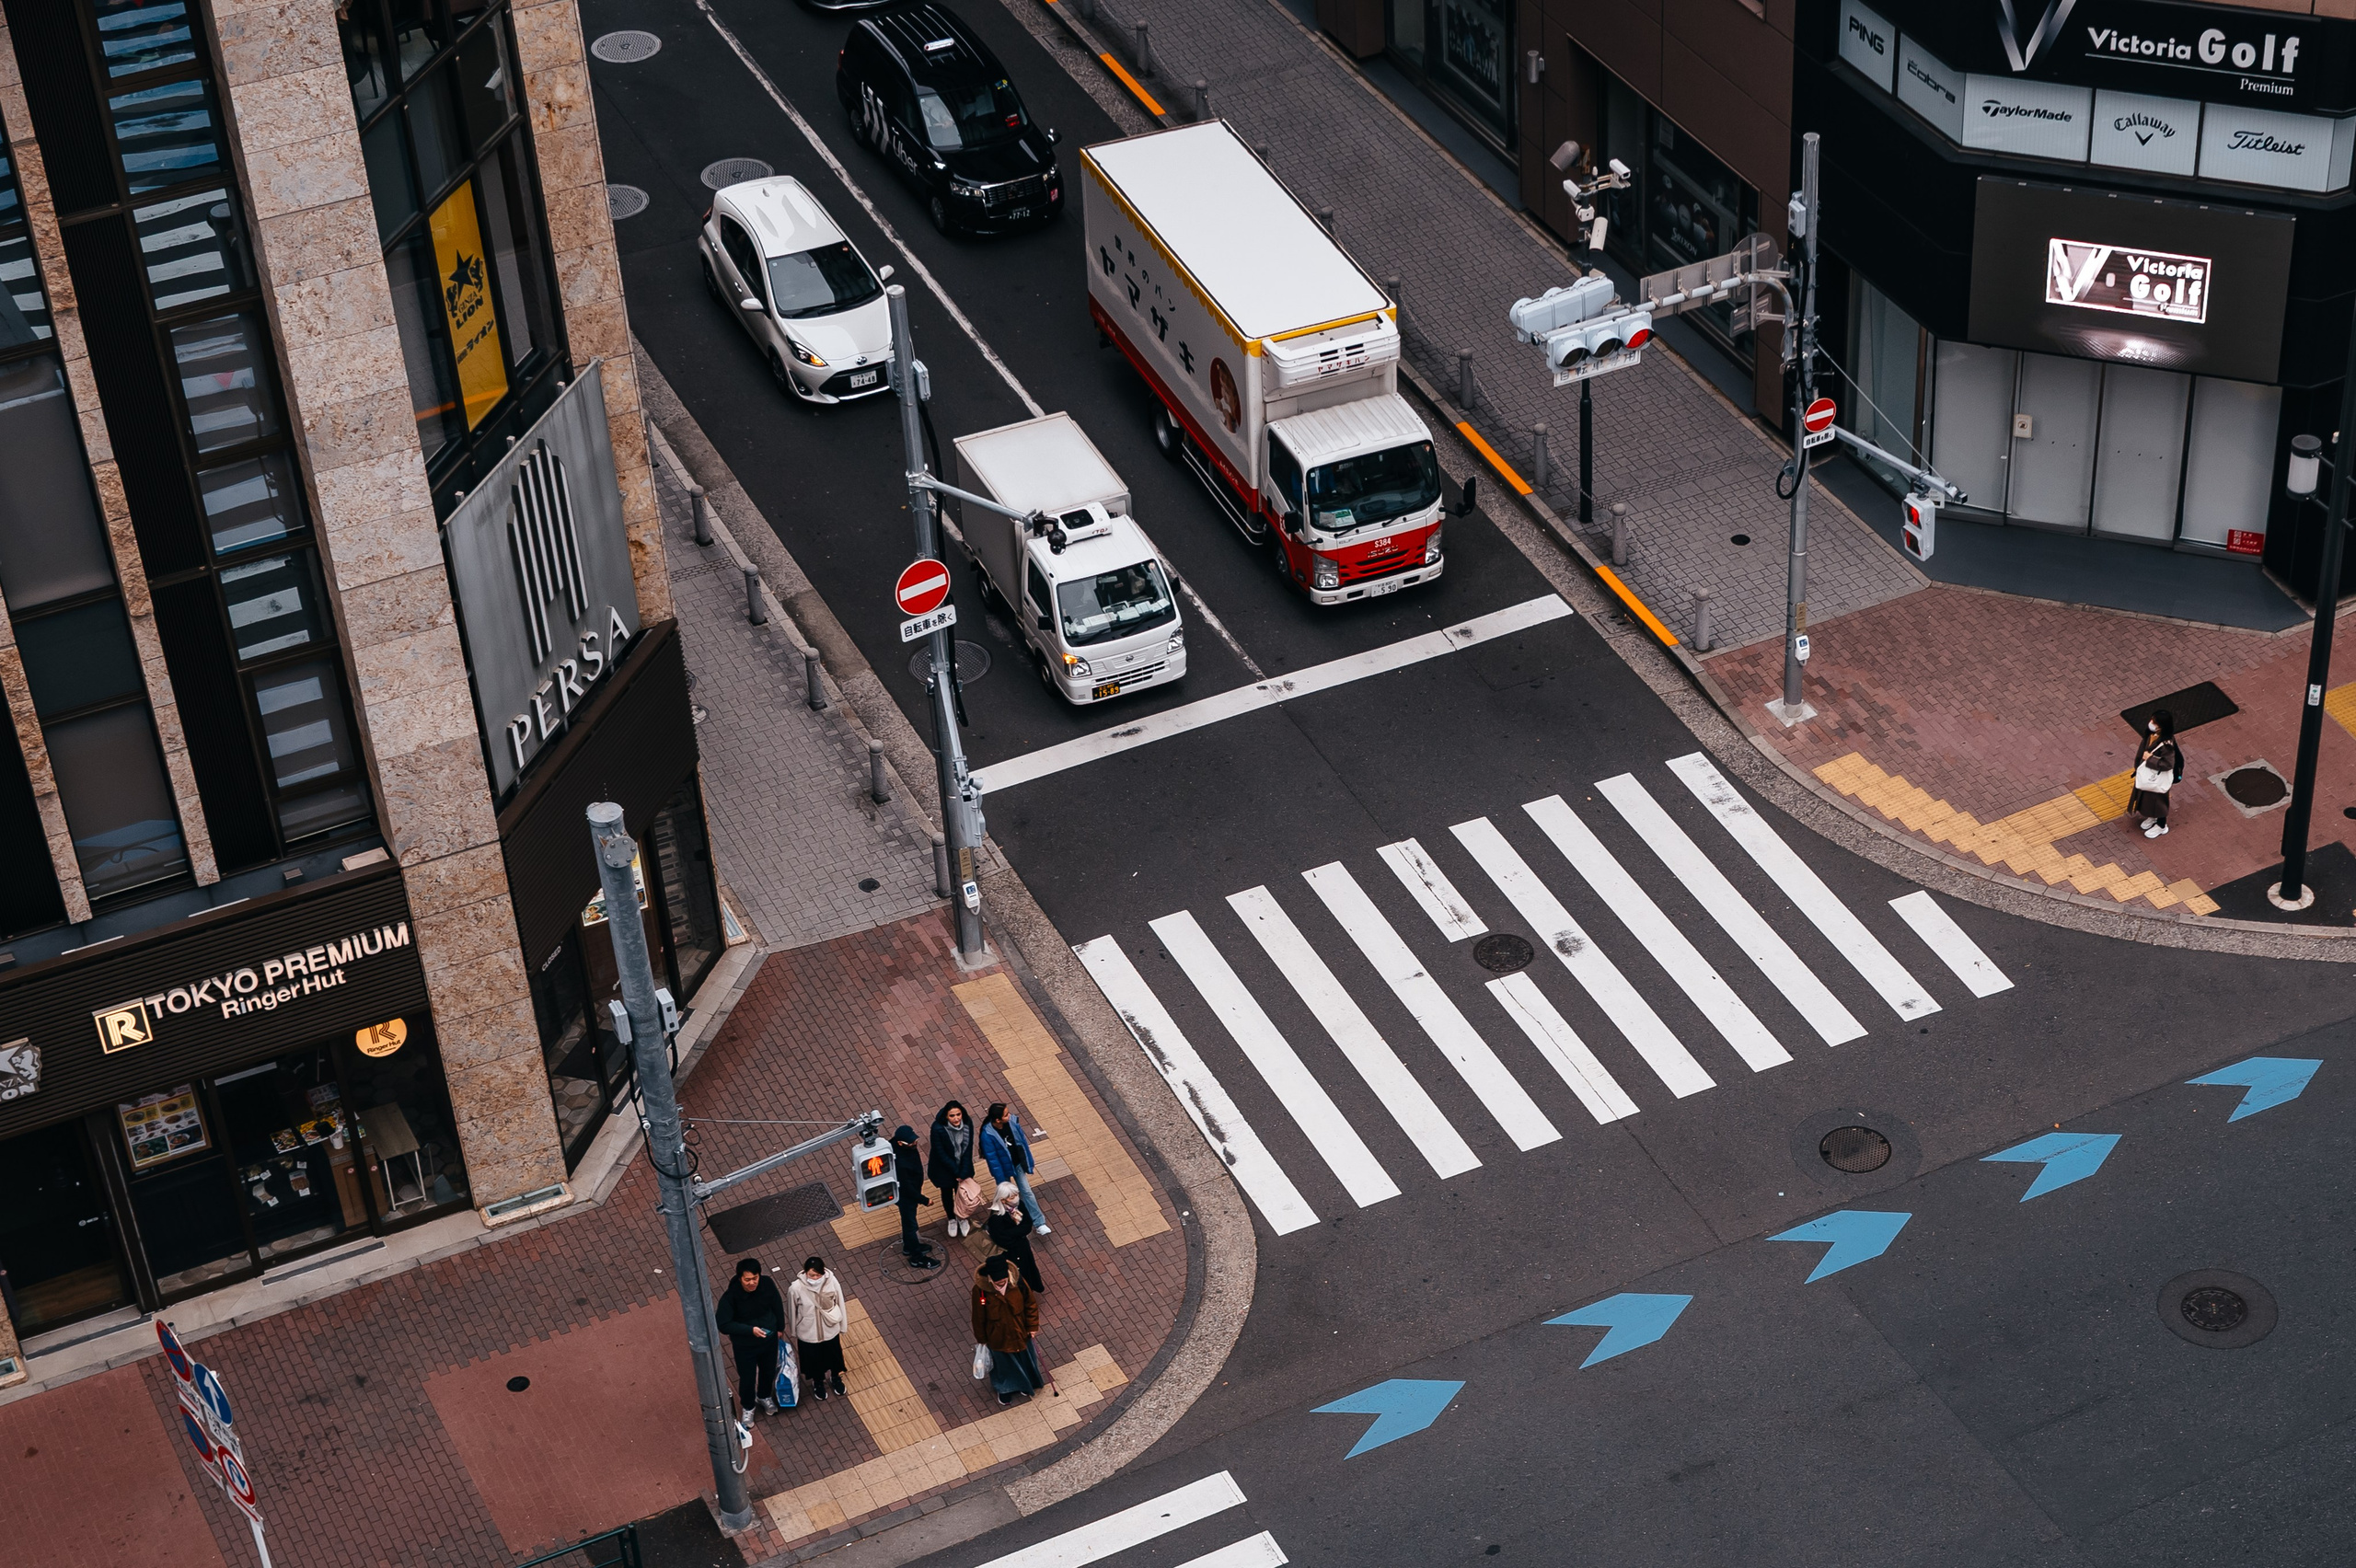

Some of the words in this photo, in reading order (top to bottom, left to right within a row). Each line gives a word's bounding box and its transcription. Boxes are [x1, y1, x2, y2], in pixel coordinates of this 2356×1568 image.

[1848, 15, 1885, 55] PING
[2087, 27, 2192, 60] Victoria
[2198, 29, 2300, 74] Golf
[2239, 77, 2294, 96] Premium
[1981, 99, 2073, 123] TaylorMade
[2113, 111, 2176, 138] Callaway
[892, 134, 918, 176] Uber
[2227, 130, 2306, 156] Titleist
[1114, 234, 1176, 312] 世界のパン
[2126, 255, 2204, 281] Victoria
[2130, 274, 2202, 306] Golf
[456, 295, 484, 330] LION
[1099, 245, 1195, 375] ヤマザキ
[1374, 537, 1392, 548] S384
[904, 612, 953, 638] 自転車を除く
[506, 605, 630, 769] PERSA
[144, 967, 259, 1019] TOKYO
[262, 922, 410, 986] PREMIUM
[542, 945, 561, 972] CLOSED
[221, 983, 301, 1020] Ringer
[303, 968, 347, 995] Hut
[367, 1043, 388, 1054] Ringer
[388, 1039, 401, 1047] Hut
